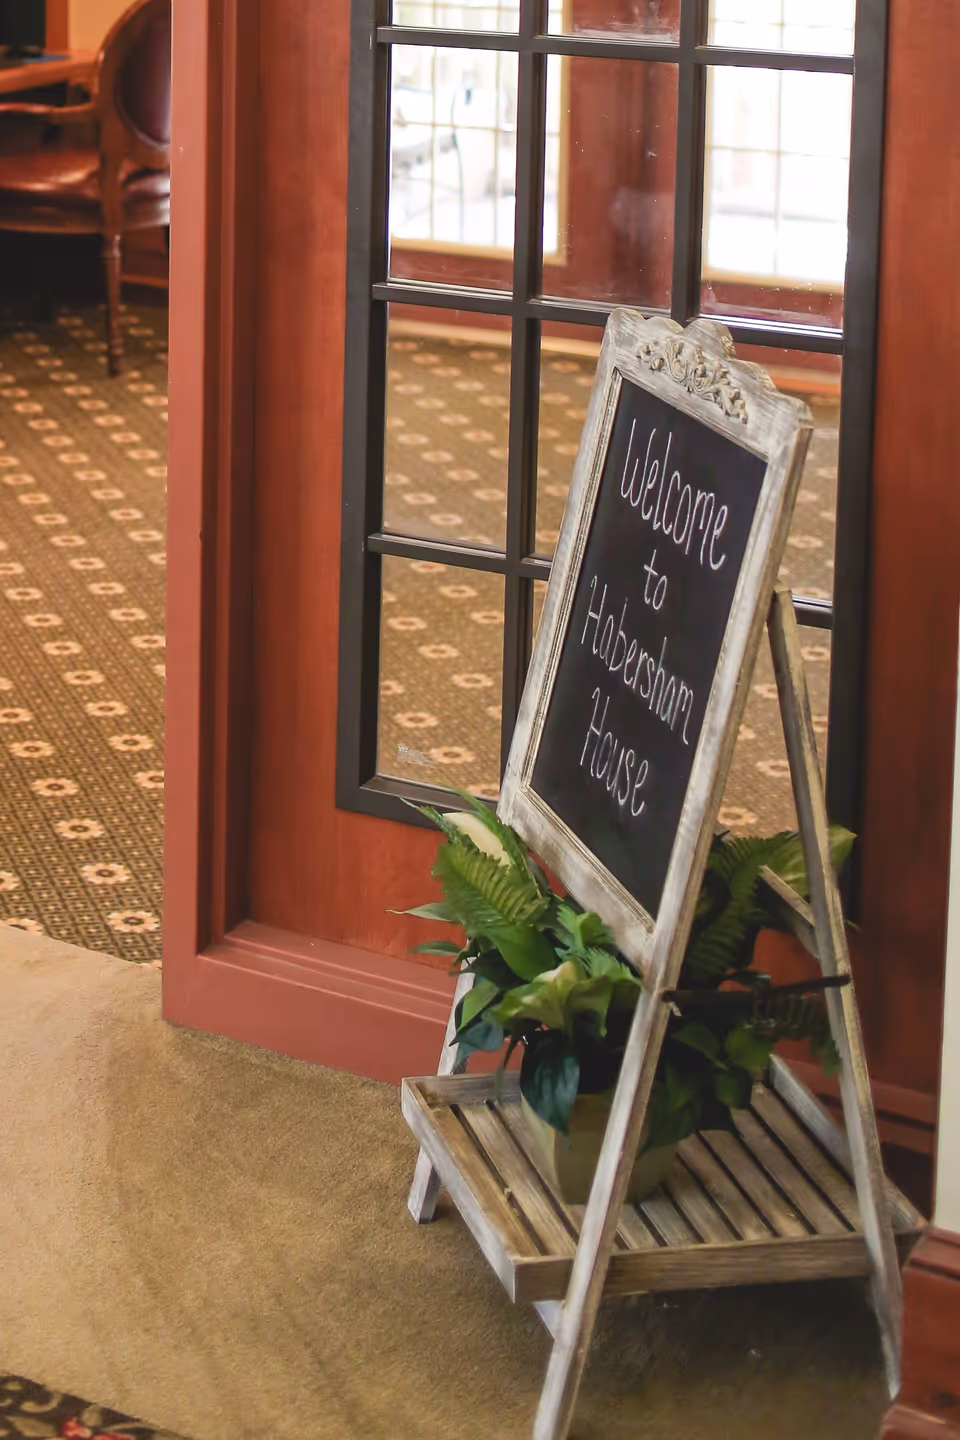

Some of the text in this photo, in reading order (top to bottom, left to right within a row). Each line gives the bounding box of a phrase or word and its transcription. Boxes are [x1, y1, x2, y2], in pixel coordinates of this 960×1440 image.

[621, 418, 729, 571] Welcome
[643, 549, 668, 611] to
[581, 575, 694, 745] Habersham
[580, 686, 649, 817] House
